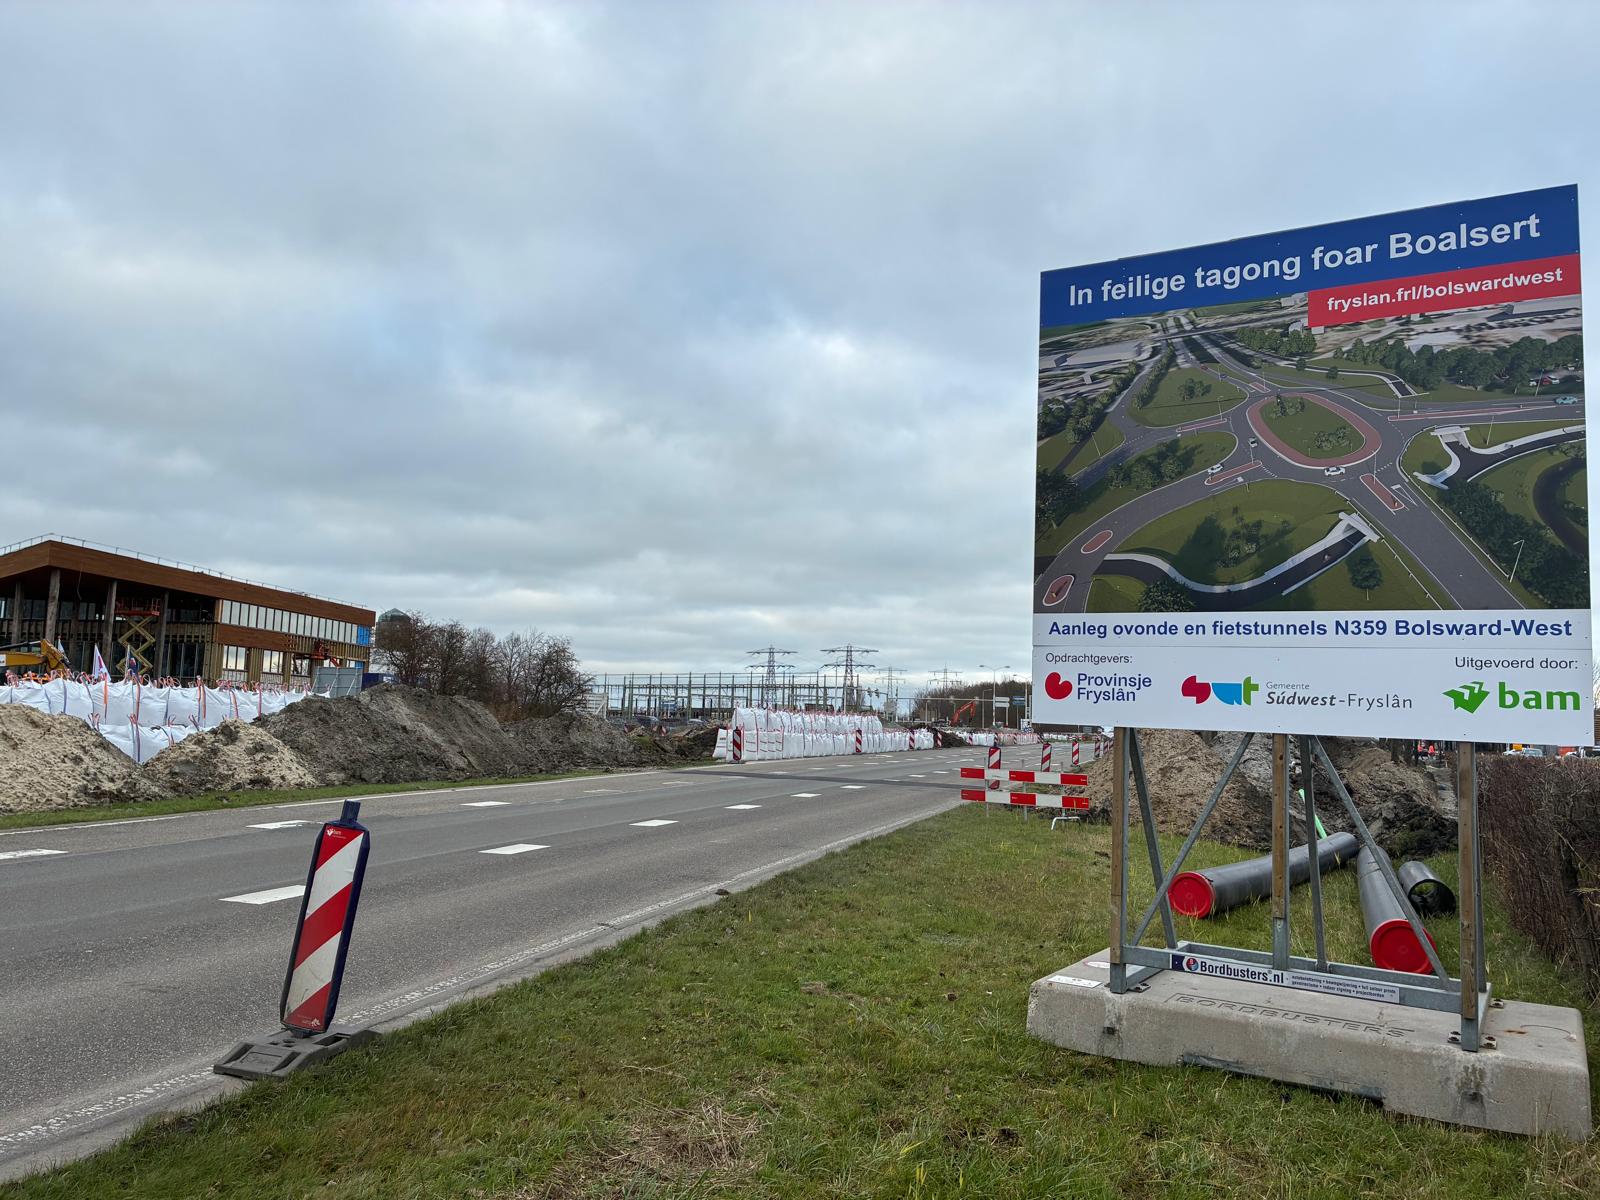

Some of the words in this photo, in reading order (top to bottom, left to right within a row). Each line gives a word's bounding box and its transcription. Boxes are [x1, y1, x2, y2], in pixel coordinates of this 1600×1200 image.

[1069, 284, 1093, 306] In
[1101, 273, 1186, 301] feilige
[1195, 255, 1301, 290] tagong
[1311, 242, 1379, 270] foar
[1389, 213, 1540, 259] Boalsert
[1327, 267, 1563, 313] fryslan.frl/bolswardwest
[1048, 621, 1107, 638] Aanleg
[1112, 621, 1179, 636] ovonde
[1184, 623, 1206, 636] en
[1212, 620, 1328, 636] fietstunnels
[1335, 620, 1388, 636] N359
[1395, 619, 1573, 636] Bolsward-West
[1045, 652, 1133, 665] Opdrachtgevers:
[1454, 656, 1535, 671] Uitgevoerd
[1539, 657, 1579, 670] door:
[1077, 673, 1152, 691] Provinsje
[1266, 681, 1310, 690] Gemeente
[1077, 687, 1136, 704] Fryslân
[1266, 691, 1413, 712] Súdwest-Fryslân
[1498, 682, 1581, 711] bam
[1176, 994, 1406, 1038] BORDBUSTERS
